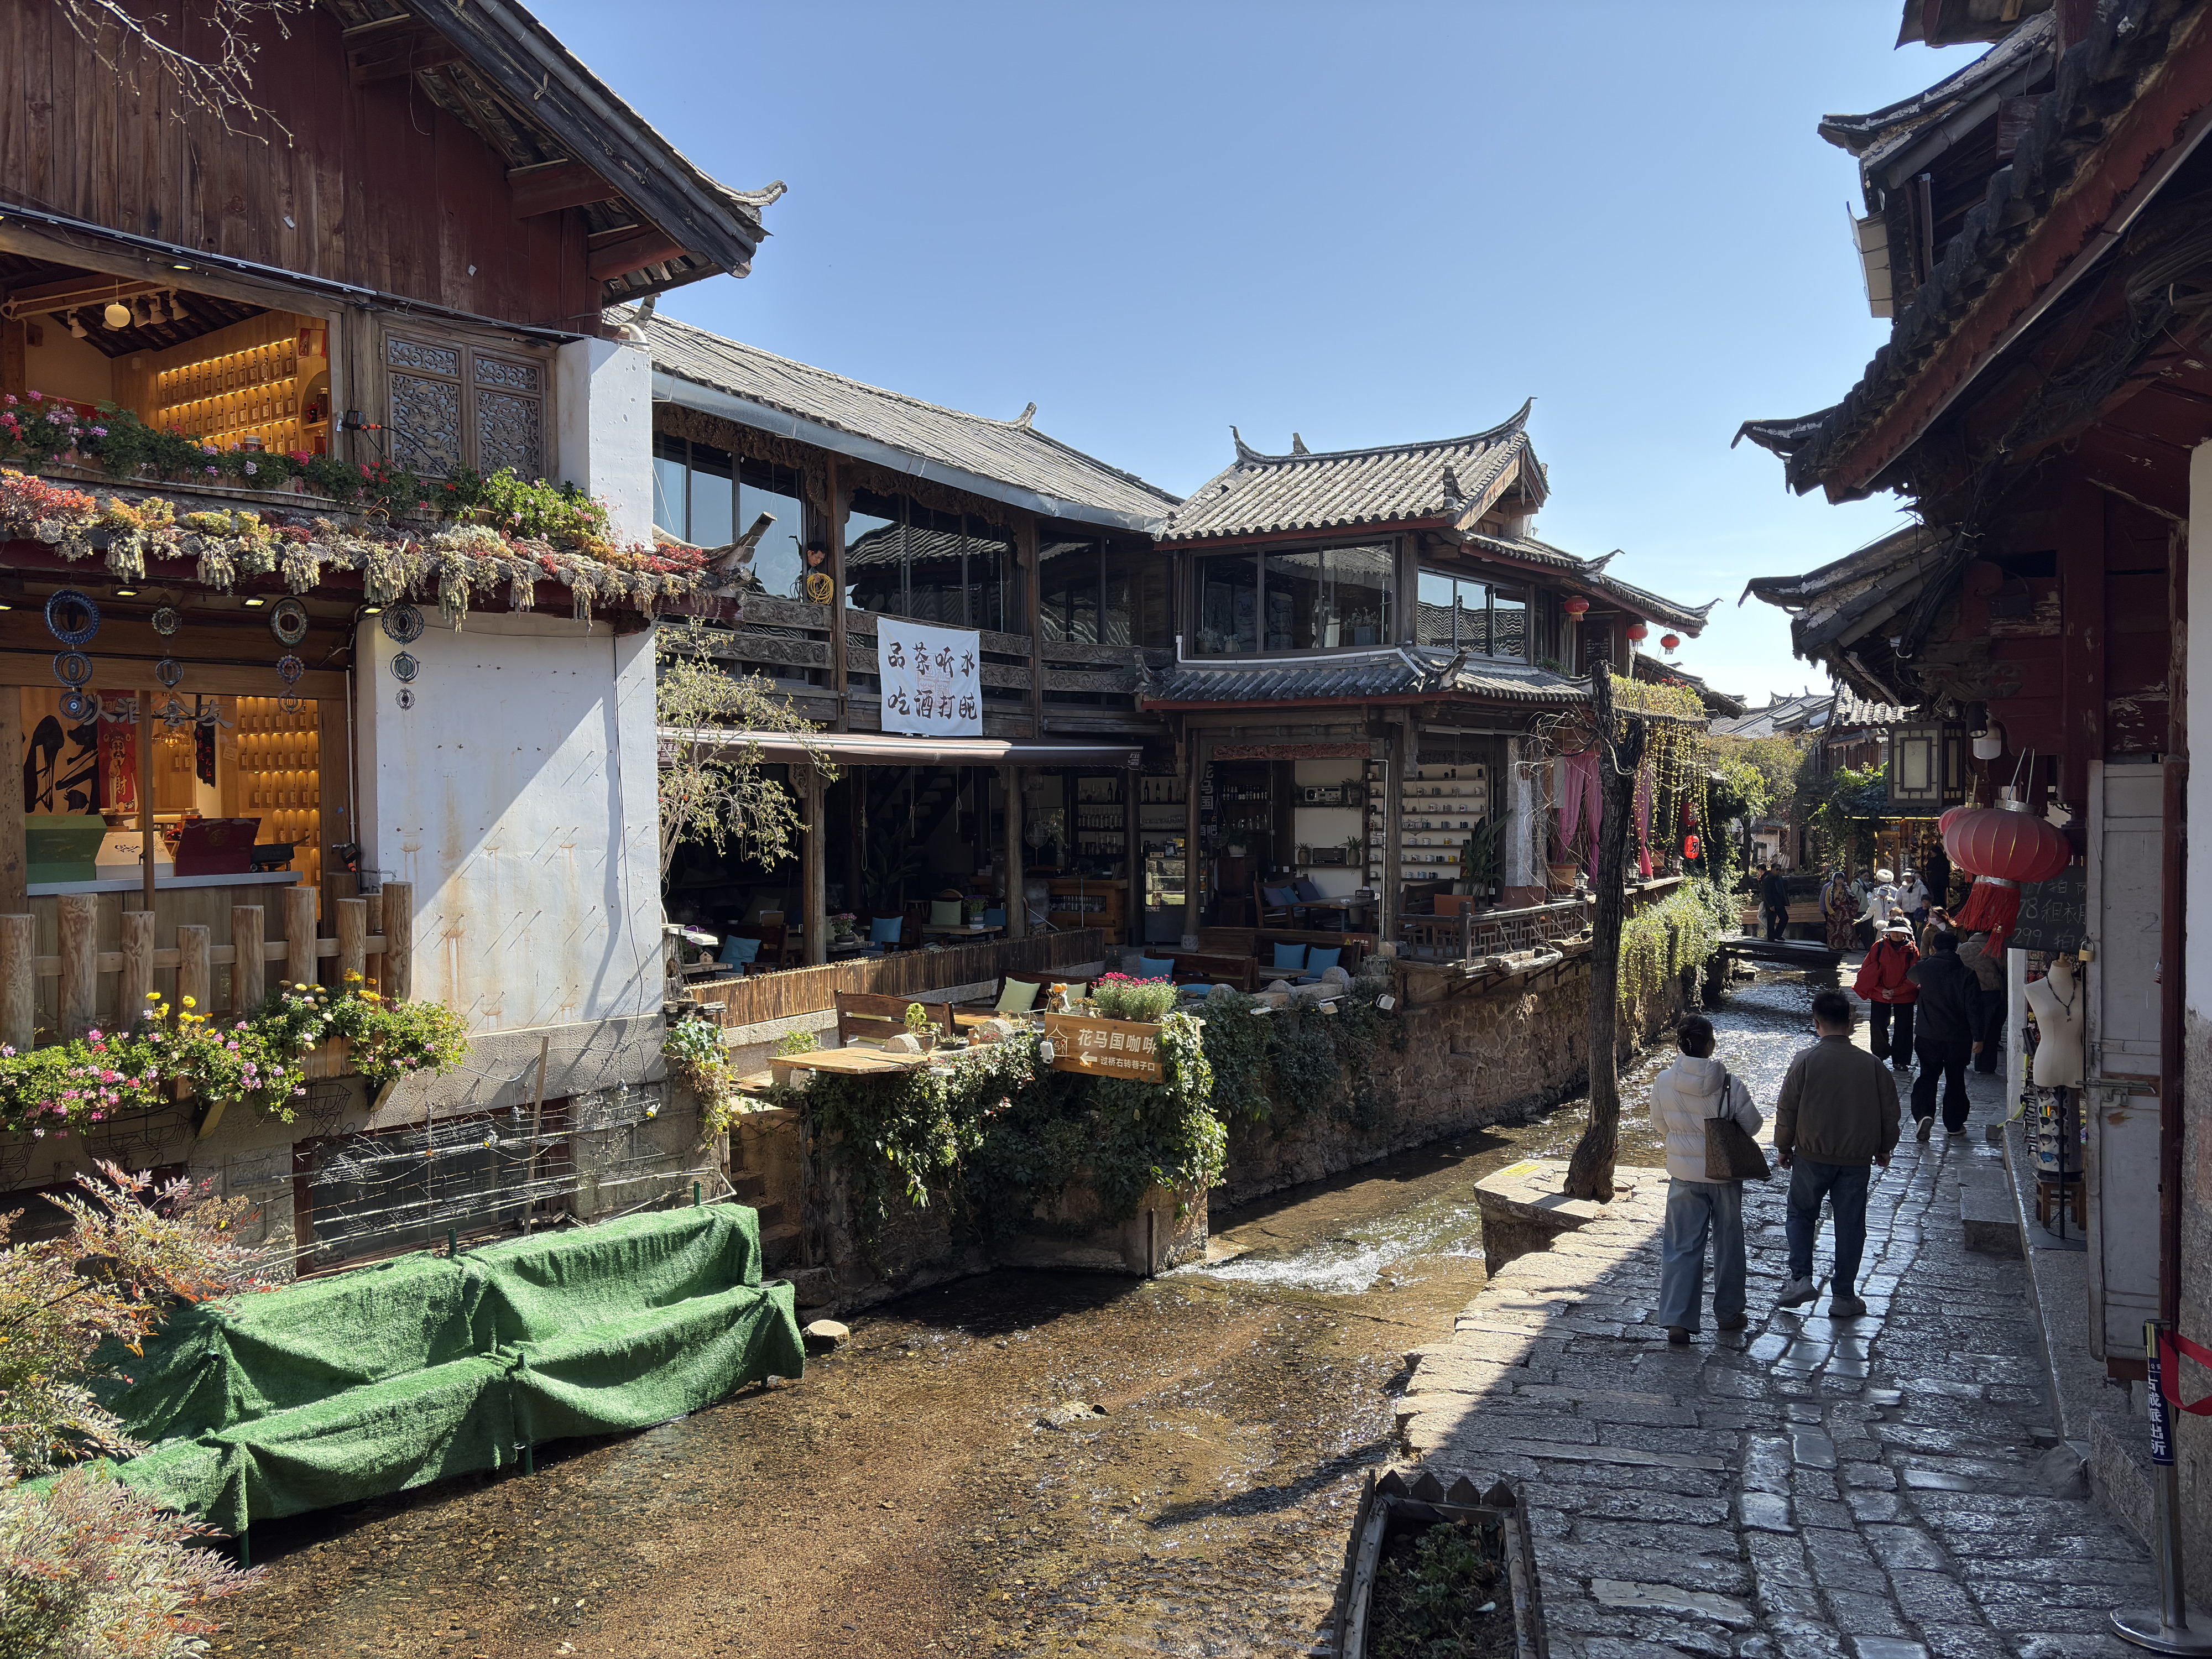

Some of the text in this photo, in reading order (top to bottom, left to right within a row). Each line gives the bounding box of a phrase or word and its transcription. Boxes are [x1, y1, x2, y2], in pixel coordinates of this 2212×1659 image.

[888, 641, 975, 678] 品茶听水
[888, 686, 978, 720] 吃酒打盹
[2012, 927, 2043, 947] 299
[1078, 1029, 1157, 1055] 花马国咖啡
[1100, 1056, 1155, 1072] 过桥右转巷子口
